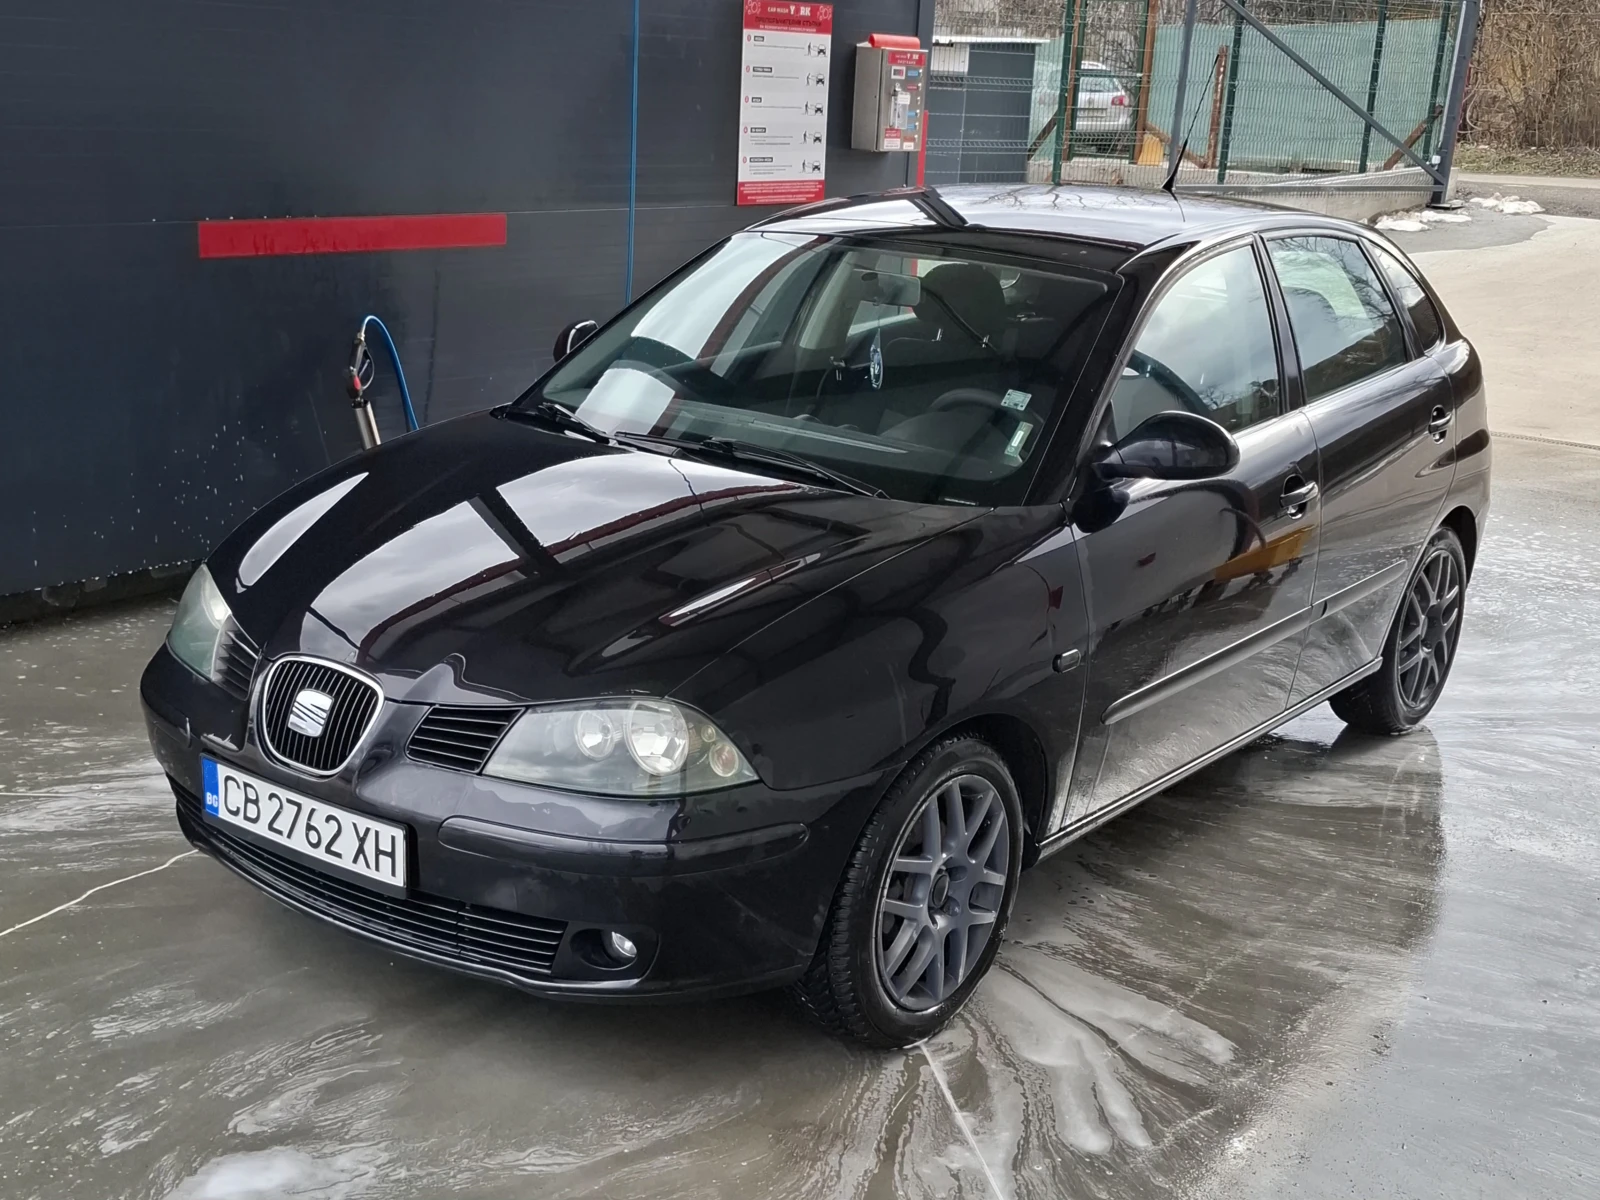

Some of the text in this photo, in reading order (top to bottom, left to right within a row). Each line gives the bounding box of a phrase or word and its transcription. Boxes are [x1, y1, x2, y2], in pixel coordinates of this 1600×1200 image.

[206, 792, 219, 808] BG
[223, 775, 396, 878] CB 2762 XH
